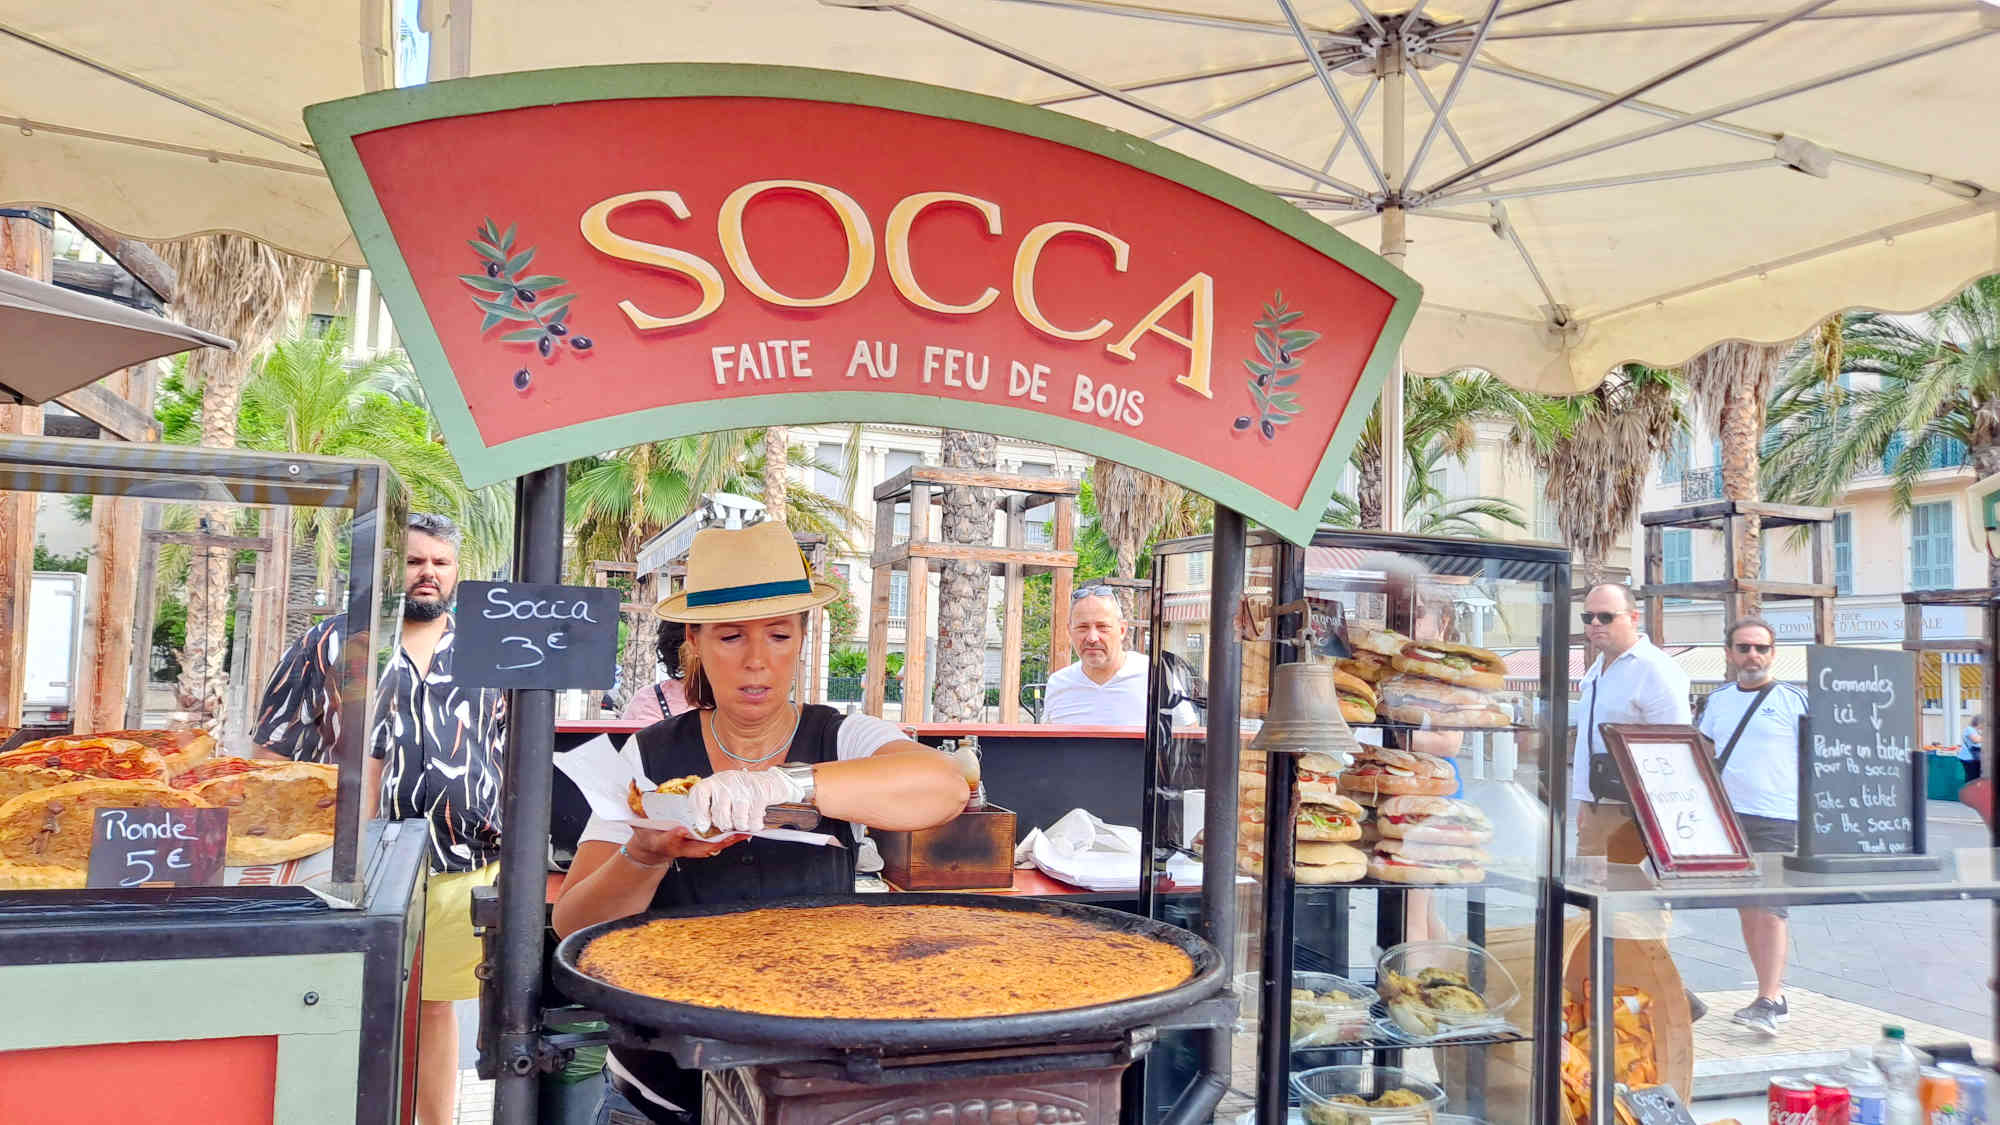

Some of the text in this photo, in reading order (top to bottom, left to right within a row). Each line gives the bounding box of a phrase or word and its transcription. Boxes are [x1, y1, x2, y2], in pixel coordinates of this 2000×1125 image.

[579, 179, 1214, 400] SOCCA
[711, 339, 1146, 427] FAITE AU FEU DE BOIS
[482, 587, 599, 624] Socca
[1819, 664, 1895, 710] Commandez
[1833, 703, 1857, 724] ici
[1813, 732, 1912, 765] Prendre un ticket
[1813, 761, 1841, 778] pour
[1813, 784, 1897, 809] Take a ticket
[101, 810, 199, 841] Ronde
[1840, 812, 1862, 834] the
